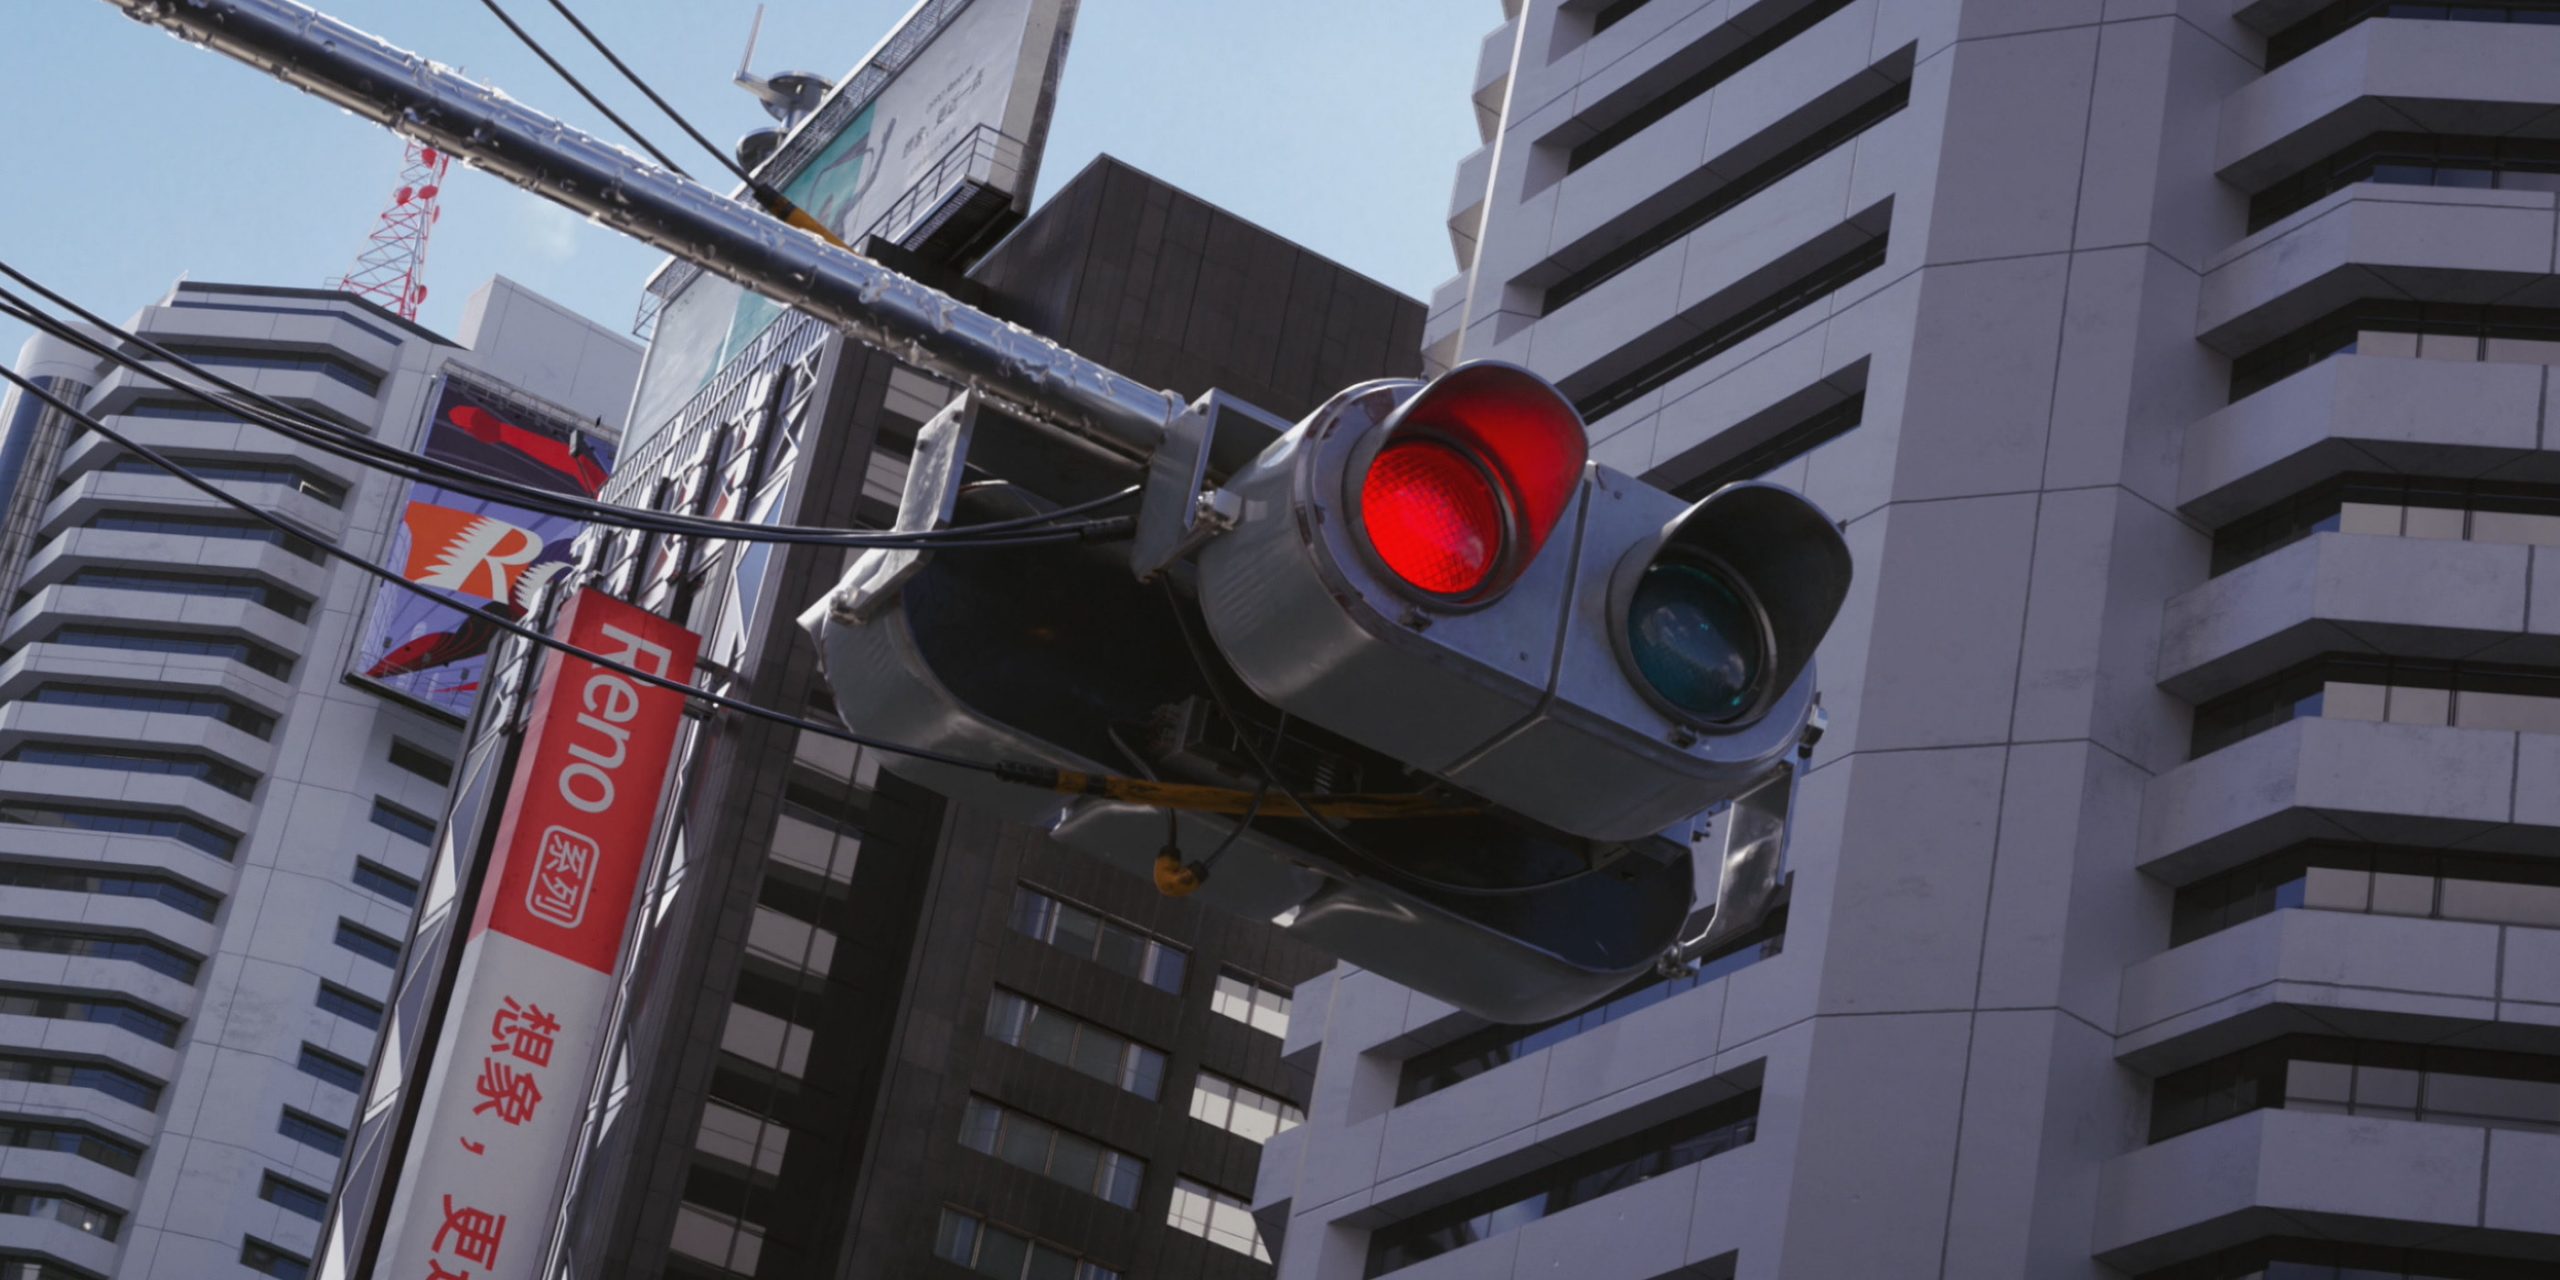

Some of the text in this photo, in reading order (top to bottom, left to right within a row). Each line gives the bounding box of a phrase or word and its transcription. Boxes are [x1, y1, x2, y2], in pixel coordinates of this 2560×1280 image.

[534, 623, 672, 919] Reno 系列
[425, 995, 561, 1280] 想象,更
